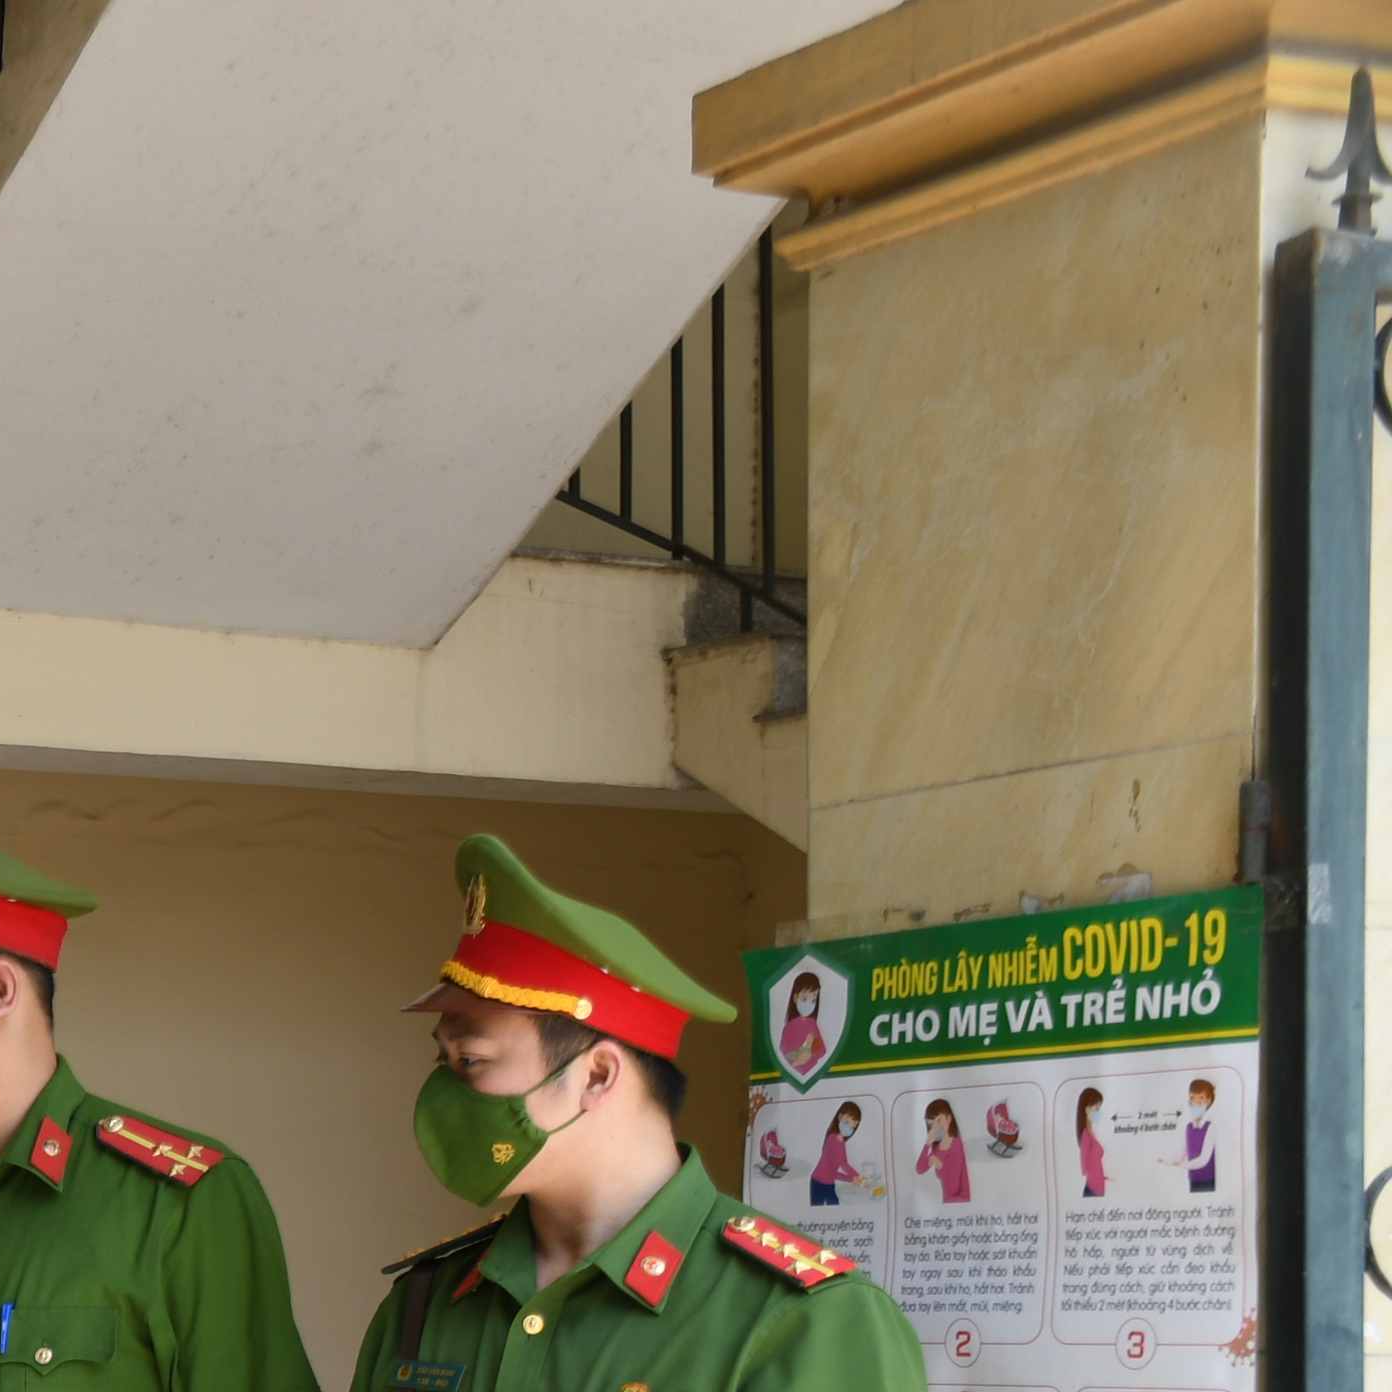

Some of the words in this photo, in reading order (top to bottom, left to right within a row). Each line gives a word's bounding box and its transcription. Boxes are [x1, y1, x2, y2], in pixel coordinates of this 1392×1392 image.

[870, 957, 938, 1002] PHÒNG
[943, 950, 984, 994] LÂY
[988, 935, 1058, 989] NHIỄM
[869, 1009, 940, 1046] CHO
[948, 1002, 999, 1045] MẸ
[1004, 990, 1053, 1033] VÀ
[1061, 979, 1126, 1029] TRẺ
[1135, 969, 1221, 1021] NHỎ
[954, 1330, 972, 1358] 2
[1126, 1331, 1145, 1359] 3
